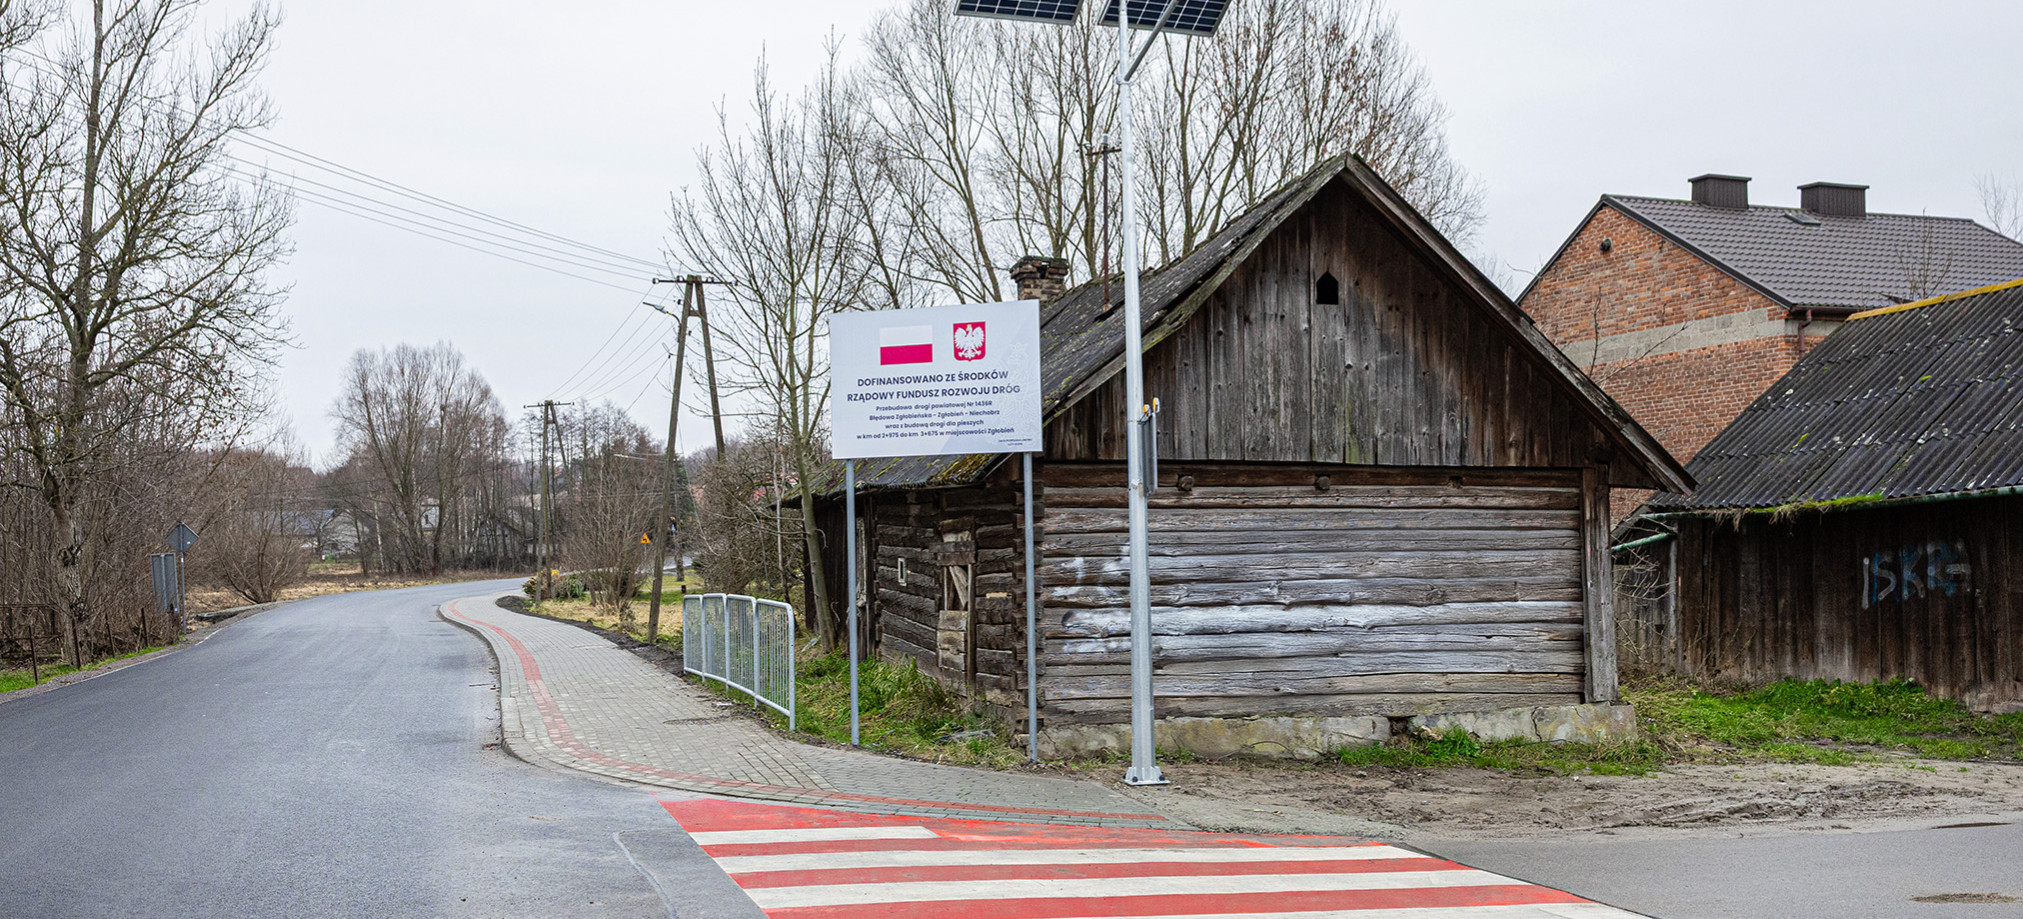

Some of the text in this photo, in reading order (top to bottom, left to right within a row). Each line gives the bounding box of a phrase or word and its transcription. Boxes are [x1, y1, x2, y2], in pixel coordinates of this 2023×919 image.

[858, 369, 1008, 386] DOFINANSOWANO ZE ŚRODKÓW
[848, 383, 1020, 402] RZĄDOWY FUNDUSZ ROZWOJU DRÓG
[931, 402, 966, 410] powiatowej
[938, 411, 964, 419] Zgłobień
[957, 419, 984, 427] pieszych
[945, 428, 986, 436] miejscowości
[988, 427, 1014, 436] Zgłobień
